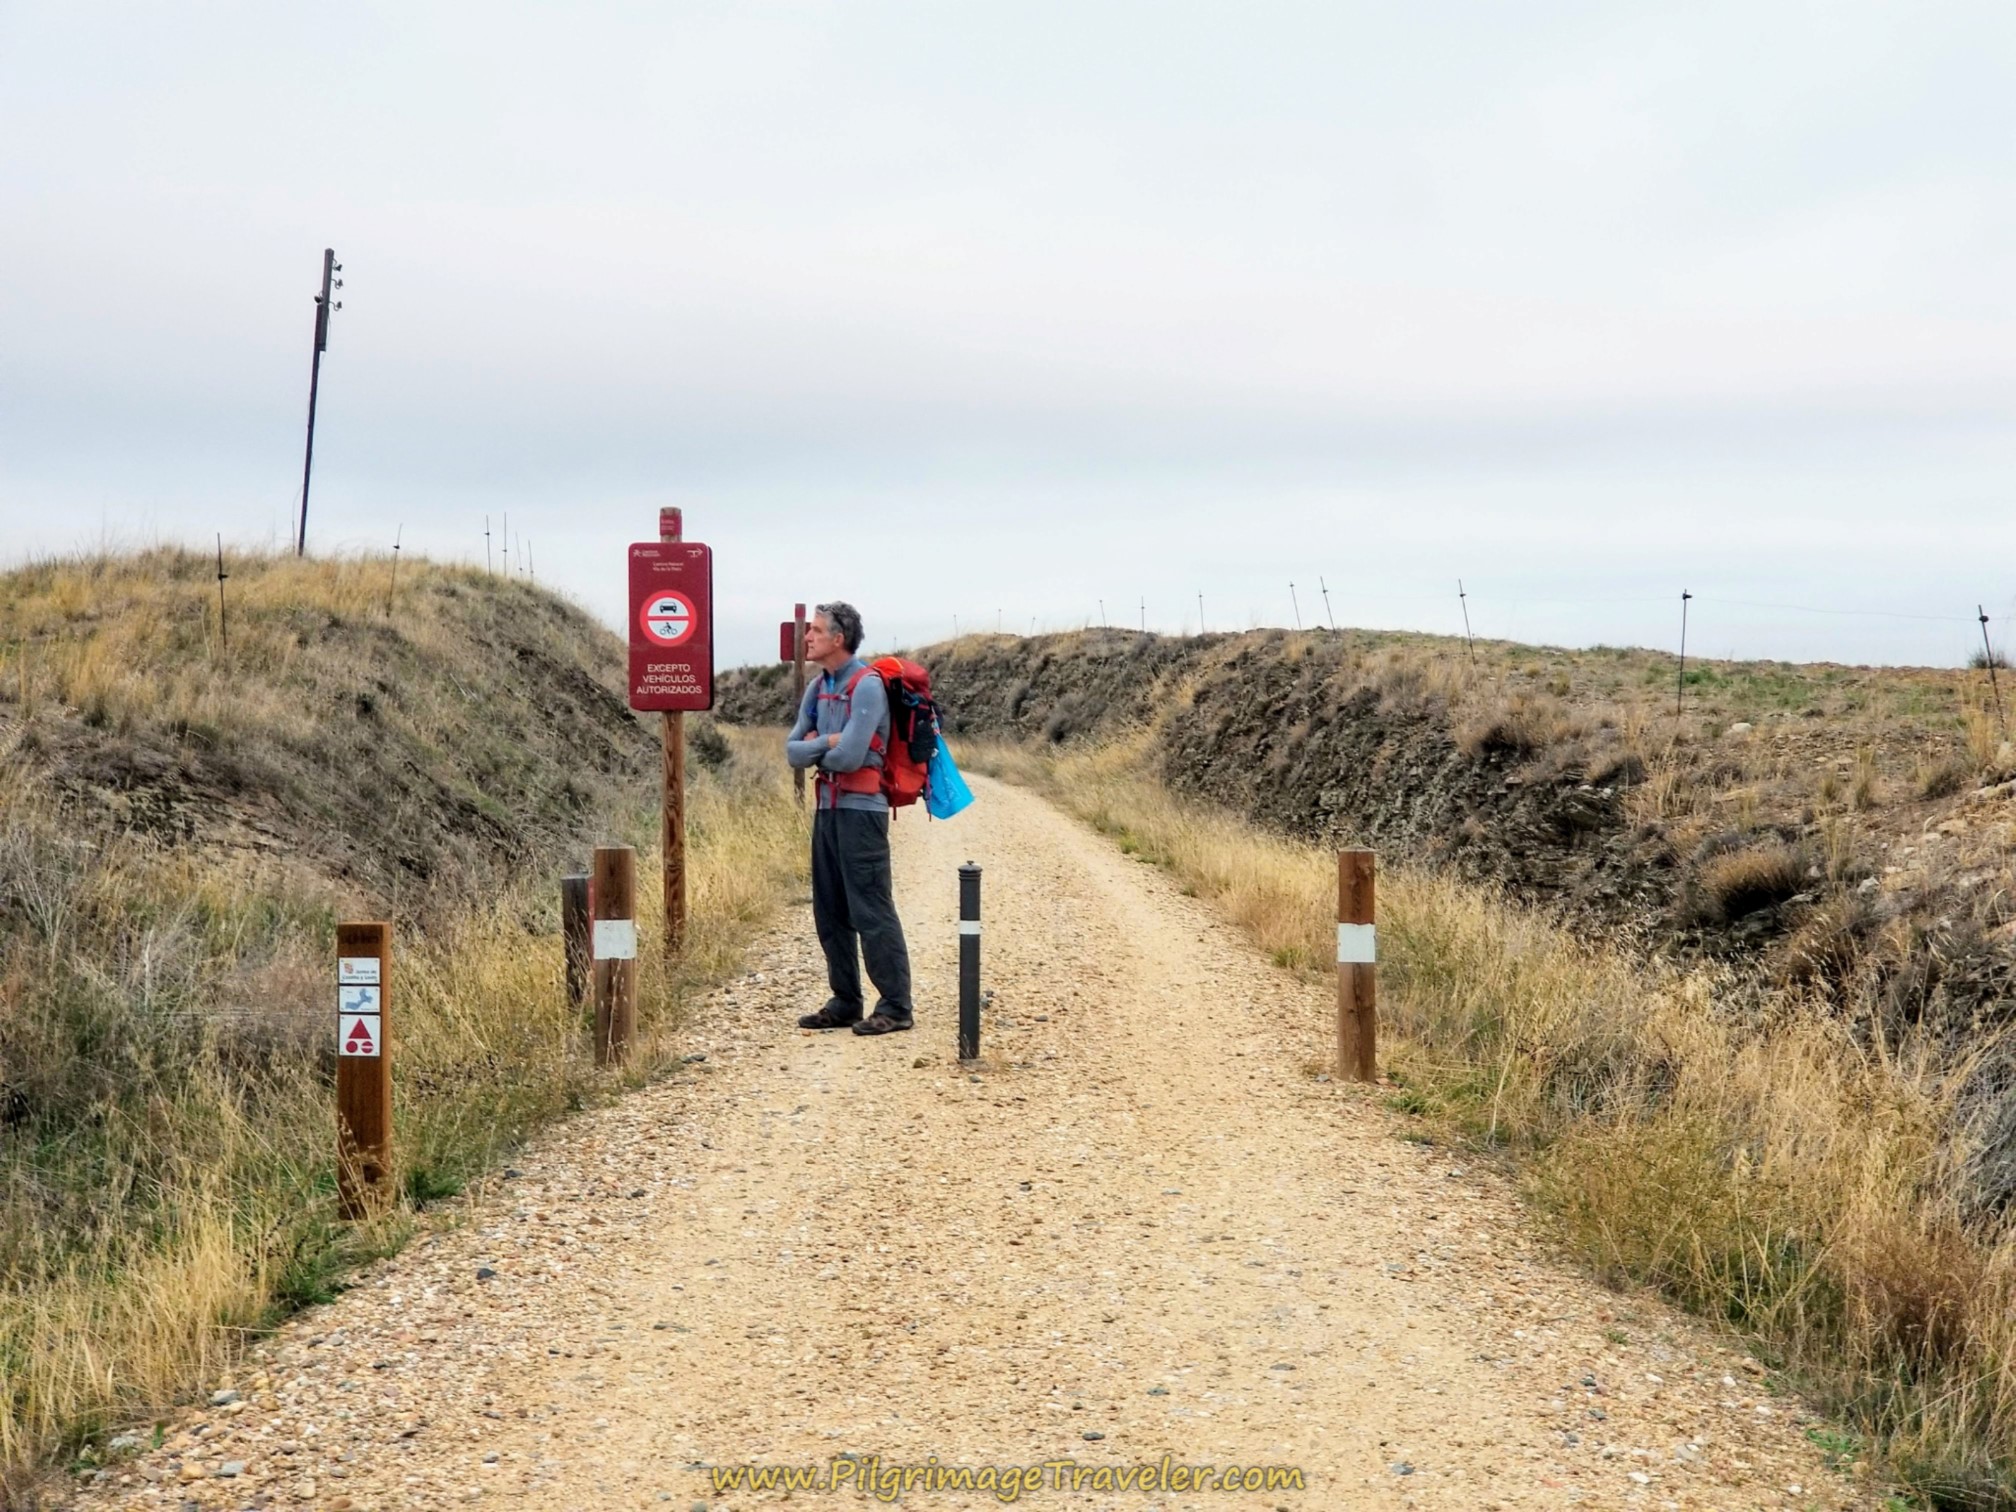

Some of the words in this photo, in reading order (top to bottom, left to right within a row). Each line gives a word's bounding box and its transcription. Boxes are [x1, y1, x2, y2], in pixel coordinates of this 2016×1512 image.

[647, 663, 691, 673] EXCEPTO
[642, 673, 696, 683] VEHÍCULOS
[636, 685, 702, 694] AUTORIZADOS
